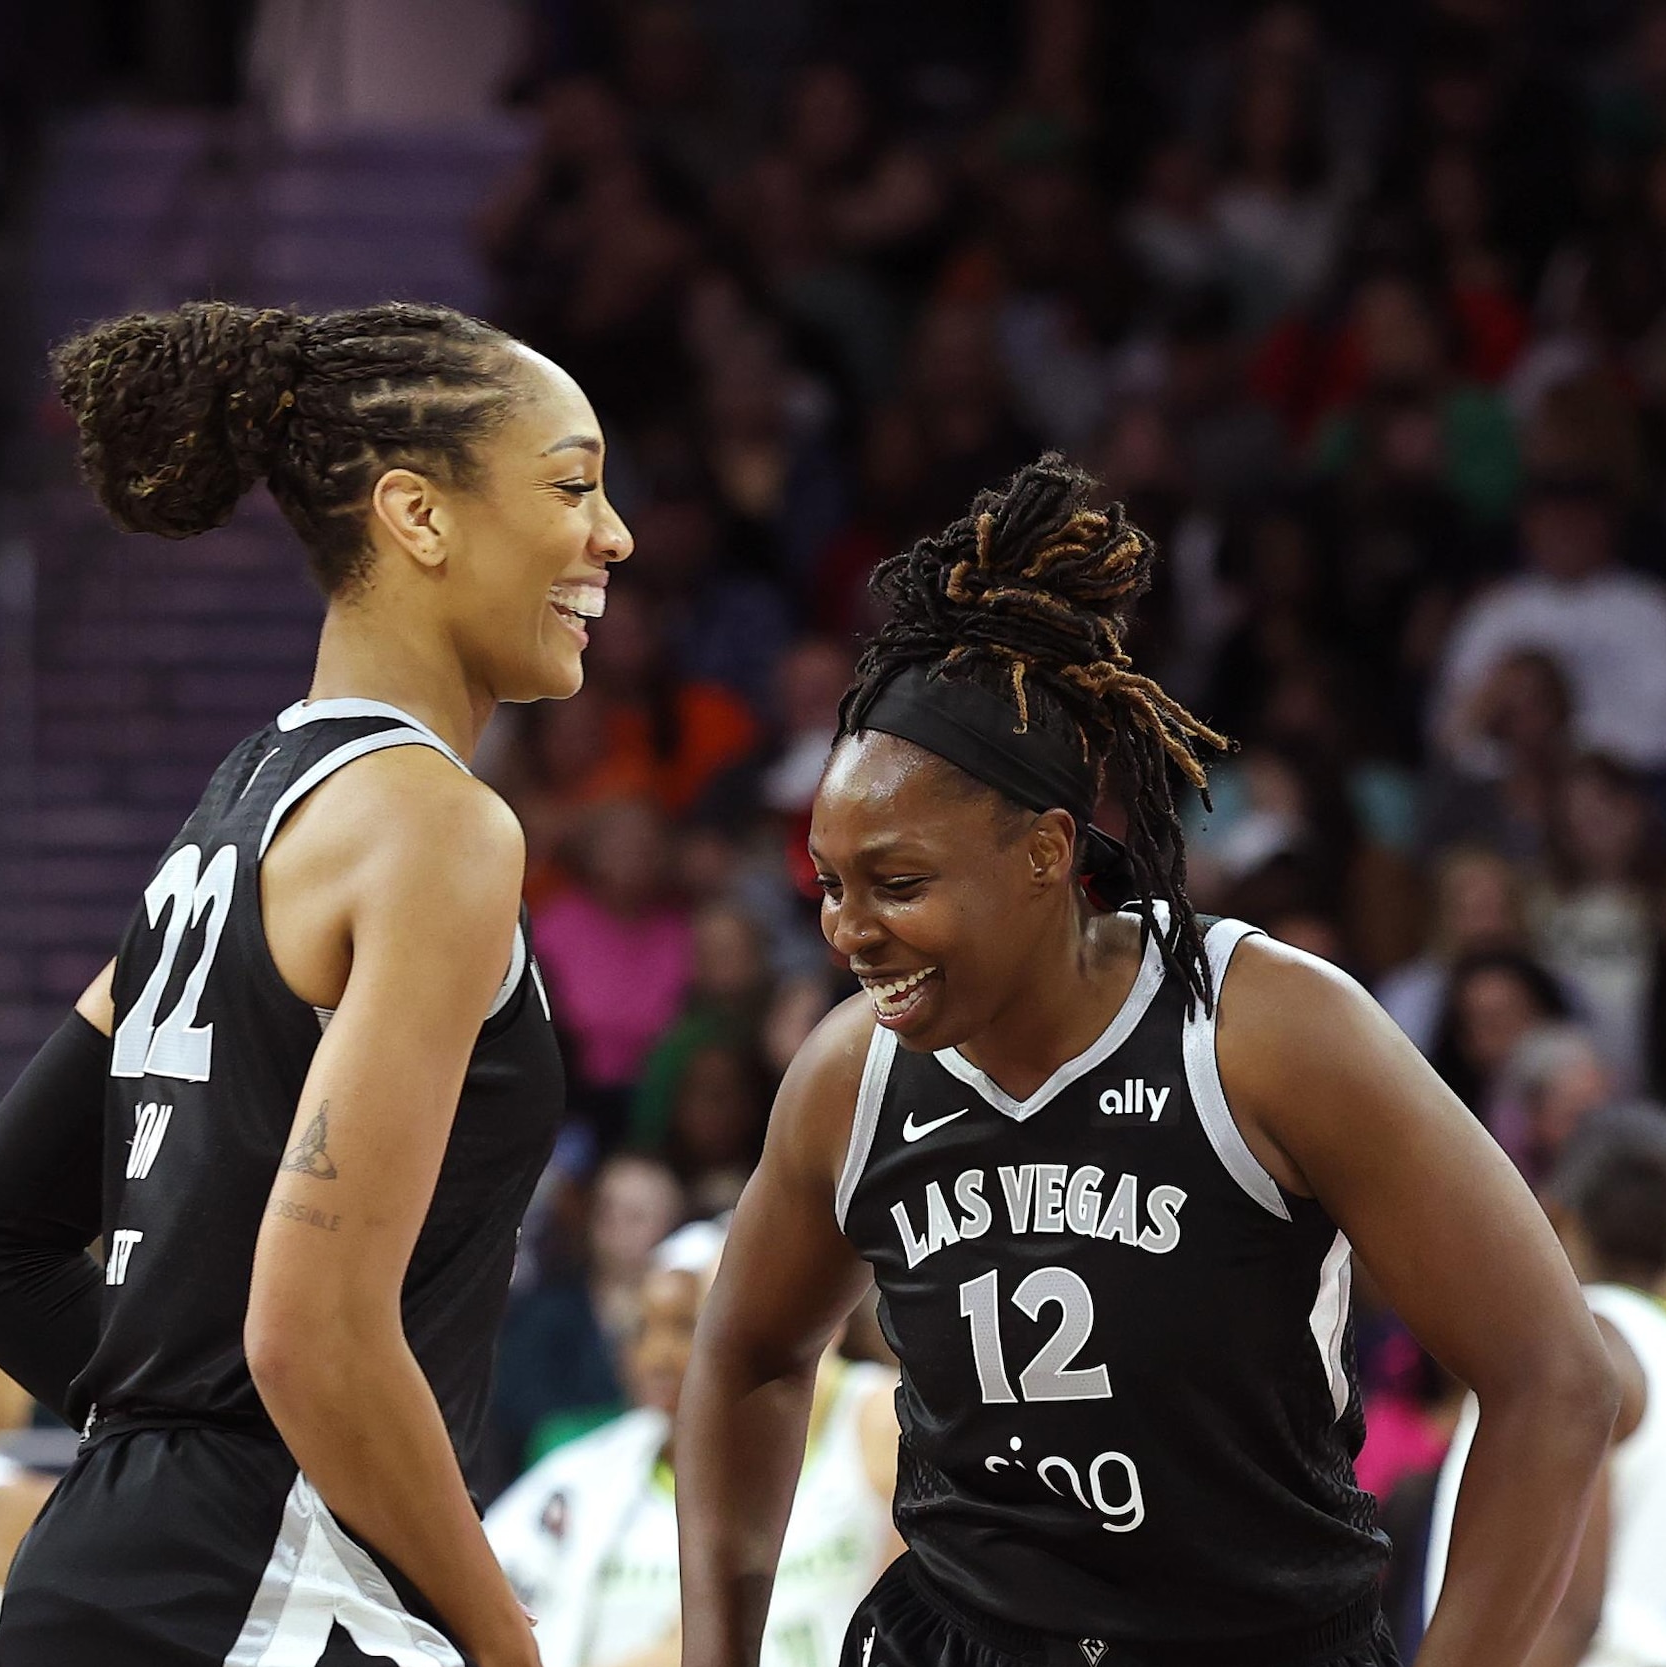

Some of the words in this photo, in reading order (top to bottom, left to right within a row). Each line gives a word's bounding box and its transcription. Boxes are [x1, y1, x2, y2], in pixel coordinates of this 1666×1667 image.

[110, 843, 238, 1082] 22
[1098, 1078, 1171, 1122] ally
[890, 1169, 993, 1270] LAS
[997, 1163, 1188, 1254] VEGAS
[958, 1266, 1113, 1404] 12
